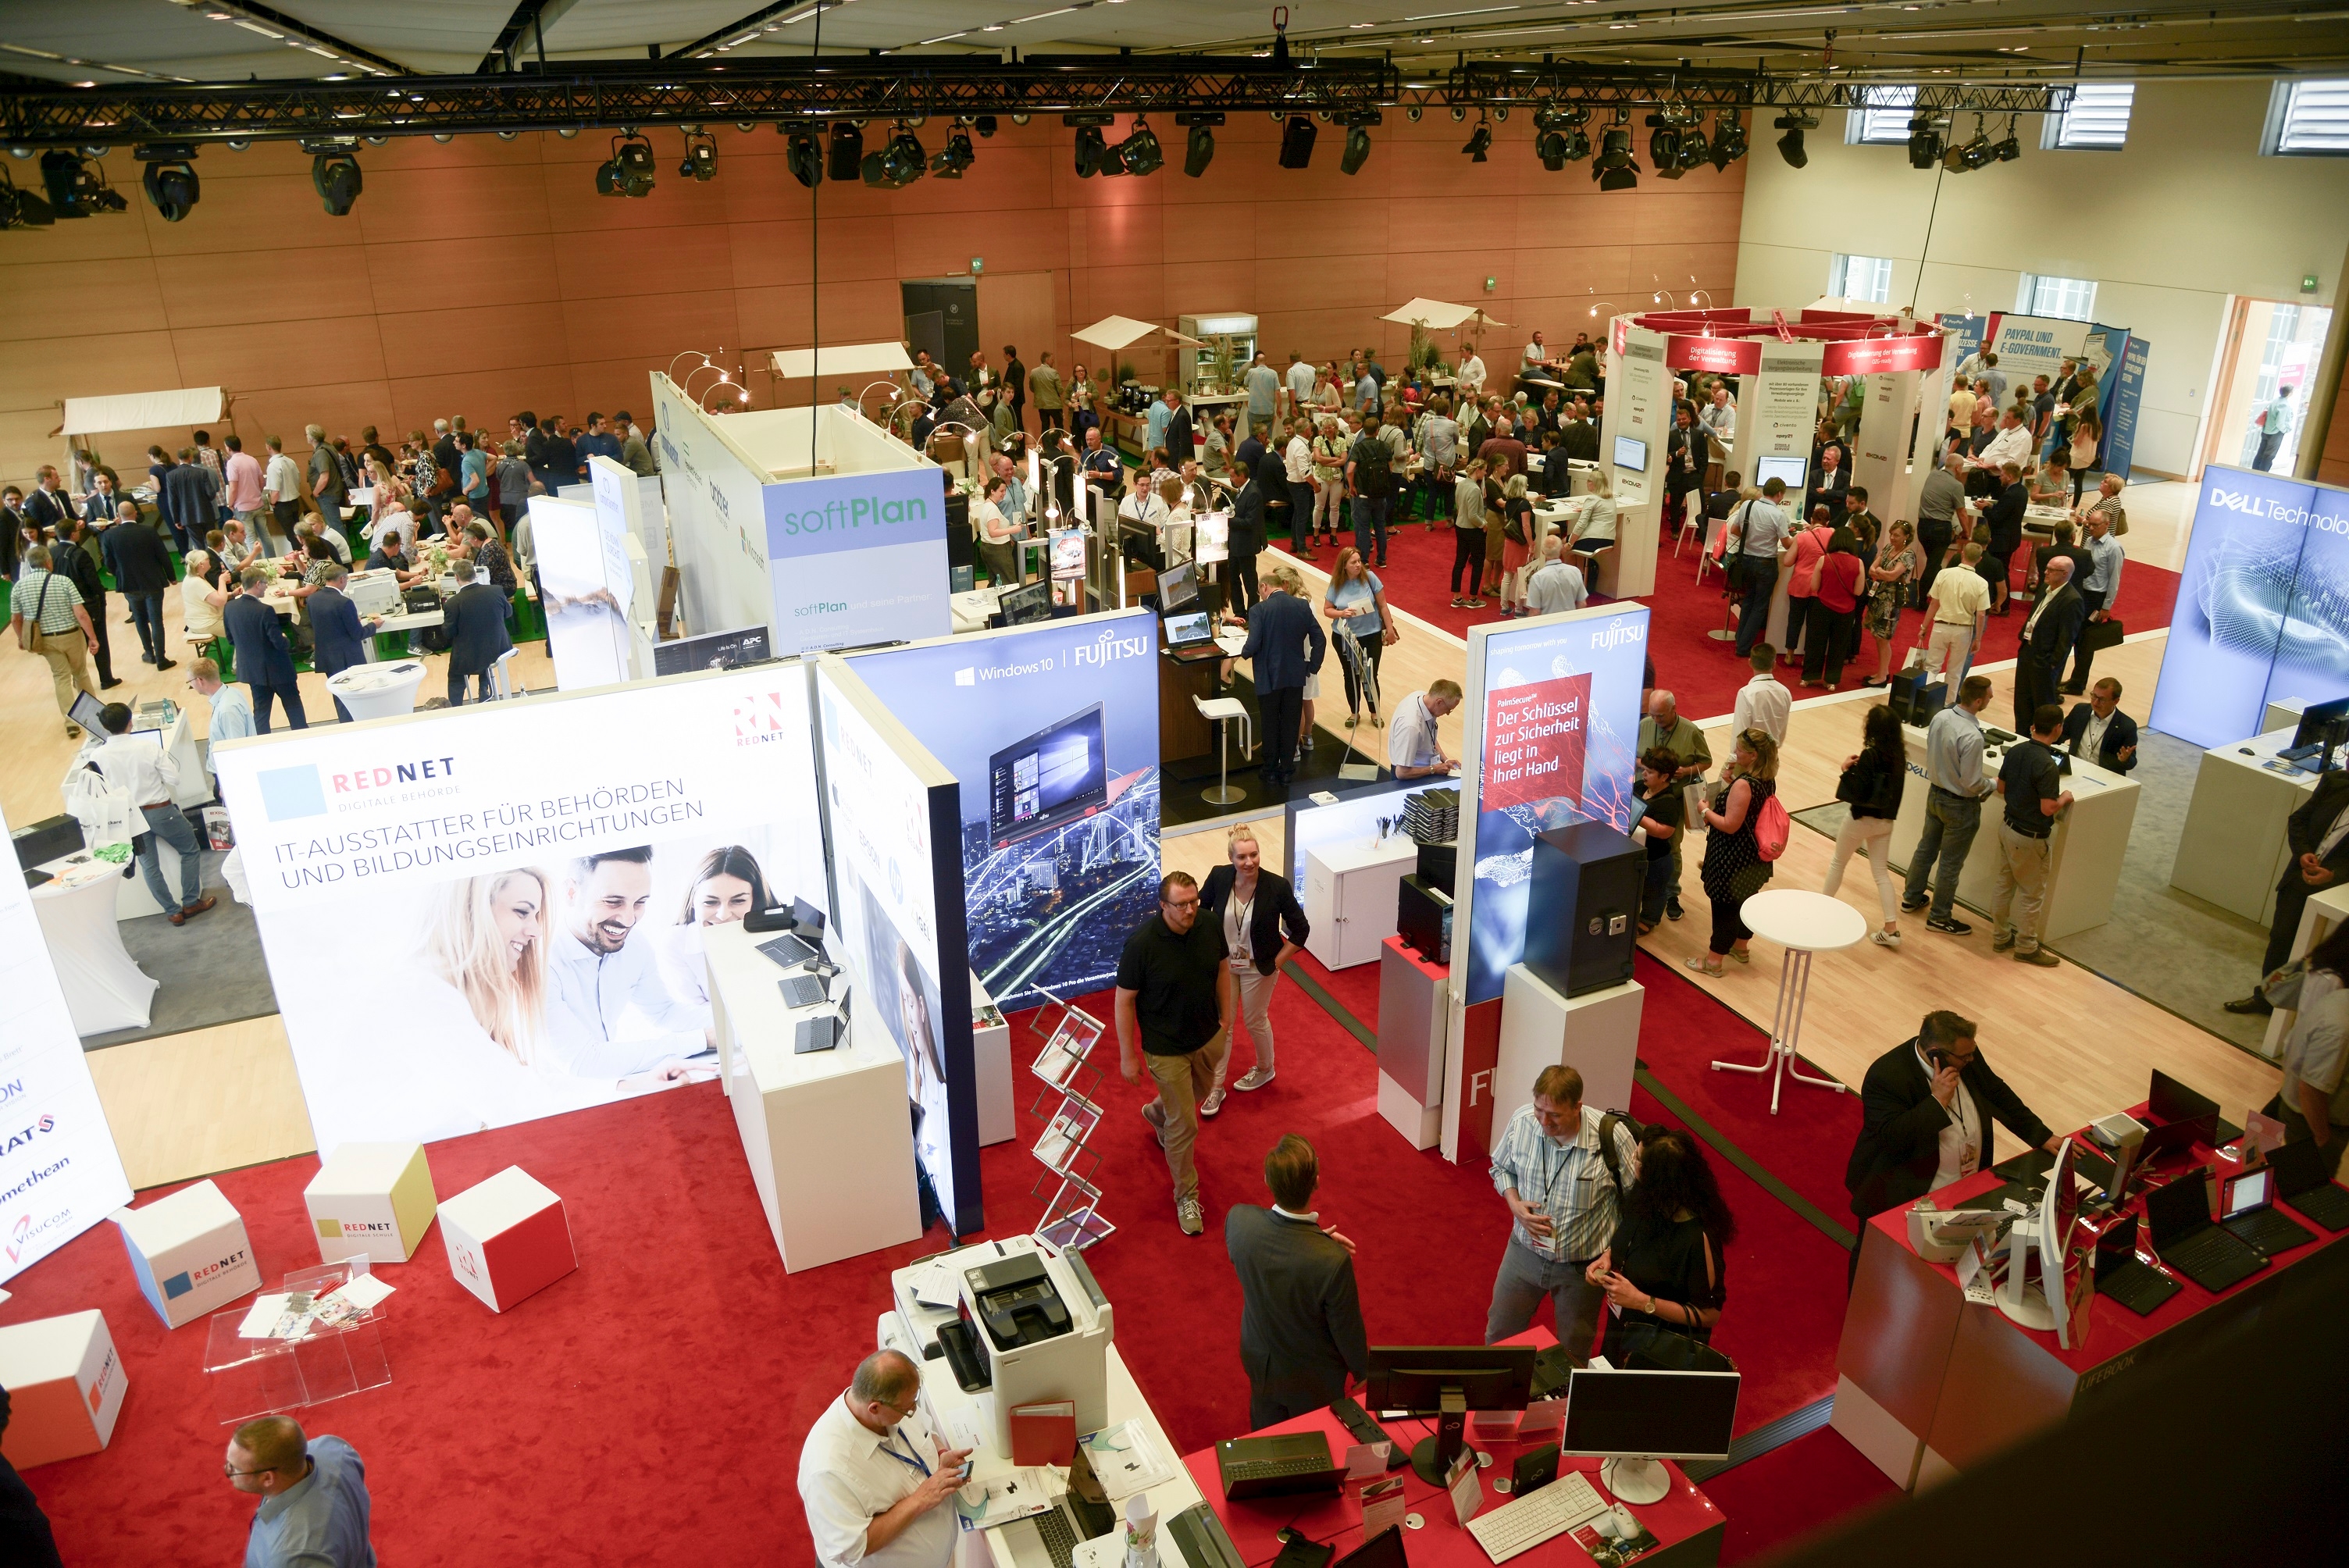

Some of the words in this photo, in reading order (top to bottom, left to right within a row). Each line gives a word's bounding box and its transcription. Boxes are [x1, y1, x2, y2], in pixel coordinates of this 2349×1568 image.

[2005, 328, 2034, 341] PAYPAL
[2035, 332, 2053, 344] UND
[1690, 347, 1737, 358] Digitalisierung
[1701, 355, 1737, 366] Verwaltung
[1848, 349, 1882, 359] Digitalisierung
[1891, 347, 1918, 355] Verwaltung
[2000, 342, 2062, 359] E-GOVERNMENT.
[784, 496, 927, 536] softPlan
[2210, 487, 2265, 517] DELL
[794, 601, 847, 617] softPlan
[850, 600, 868, 610] und
[870, 595, 895, 608] seine
[896, 593, 933, 605] Partner:
[743, 636, 762, 646] APC
[819, 624, 850, 633] Consulting
[831, 630, 843, 639] und
[850, 625, 885, 636] Systemhaus
[1591, 618, 1645, 652] FUJITSU
[1074, 629, 1148, 668] FUJITSU
[1490, 647, 1513, 656] shaping
[1513, 642, 1543, 652] tomorrow
[1543, 639, 1556, 647] with
[1556, 638, 1568, 647] you
[979, 661, 1039, 681] Windows
[1040, 657, 1053, 672] 10
[1496, 711, 1520, 727] Der
[1521, 697, 1578, 722] Schlüssel
[736, 732, 784, 747] REDNET
[1495, 731, 1515, 747] zur
[1517, 717, 1580, 742] Sicherheit
[840, 725, 873, 779] REDNET
[1494, 747, 1524, 766] liegt
[1526, 745, 1538, 757] in
[332, 757, 454, 793] REDNET
[1493, 767, 1523, 784] Ihrer
[1525, 756, 1559, 777] Hand
[338, 796, 397, 812] DIGITALE
[401, 785, 462, 802] BEHÖRDE
[275, 814, 476, 863] IT-AUSSTATTER
[483, 803, 533, 829] FÜR
[541, 778, 684, 819] BEHÖRDEN
[282, 862, 344, 889] UND
[354, 800, 704, 877] BILDUNGSEINRICHTUNGEN
[859, 828, 881, 871] EPSON
[907, 832, 925, 861] REDNET
[914, 914, 931, 942] IGEL
[1085, 970, 1117, 982] Verantwortung
[0, 1156, 70, 1205] methean
[344, 1223, 390, 1231] REDNET
[194, 1249, 245, 1281] REDNET
[196, 1272, 222, 1288] DIGITALE
[221, 1260, 248, 1278] BEHÖRDE
[460, 1263, 479, 1281] REDNET
[98, 1347, 114, 1388] REDNET
[2080, 1352, 2137, 1392] LIFEBOOK
